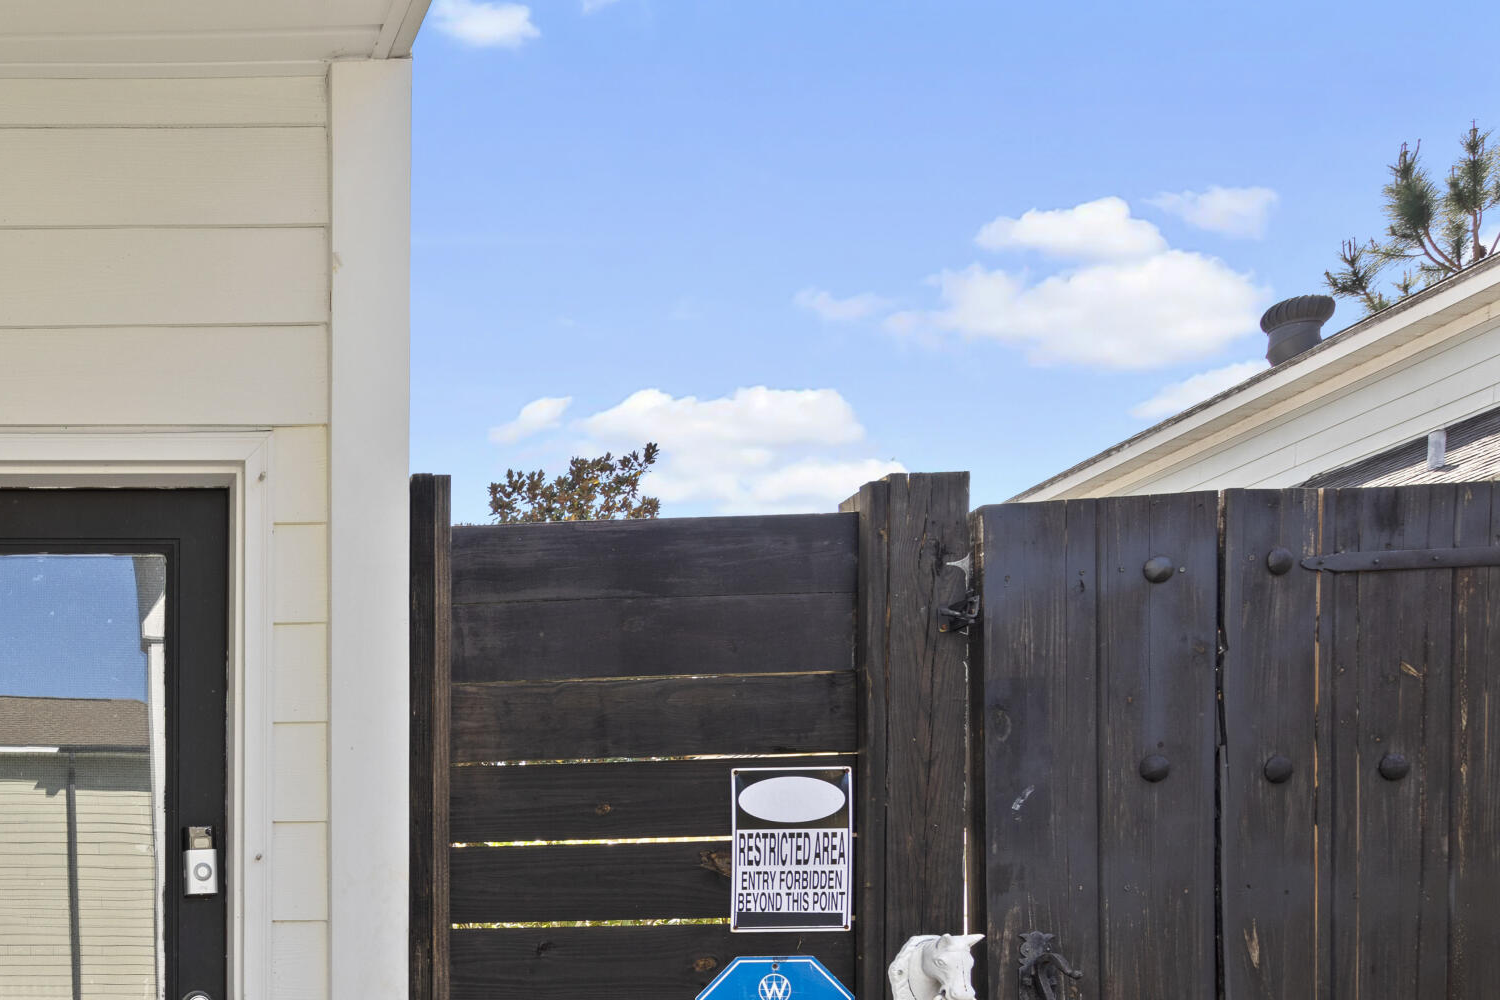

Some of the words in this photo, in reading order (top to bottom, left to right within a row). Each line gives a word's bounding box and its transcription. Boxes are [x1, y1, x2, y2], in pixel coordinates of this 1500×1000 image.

[738, 832, 811, 866] RESTRICTED
[813, 831, 846, 865] AREA
[741, 871, 776, 890] ENTRY
[779, 870, 843, 890] FORBIDDEN
[738, 892, 783, 912] BEYOND
[786, 892, 810, 911] THIS
[813, 891, 846, 911] POINT
